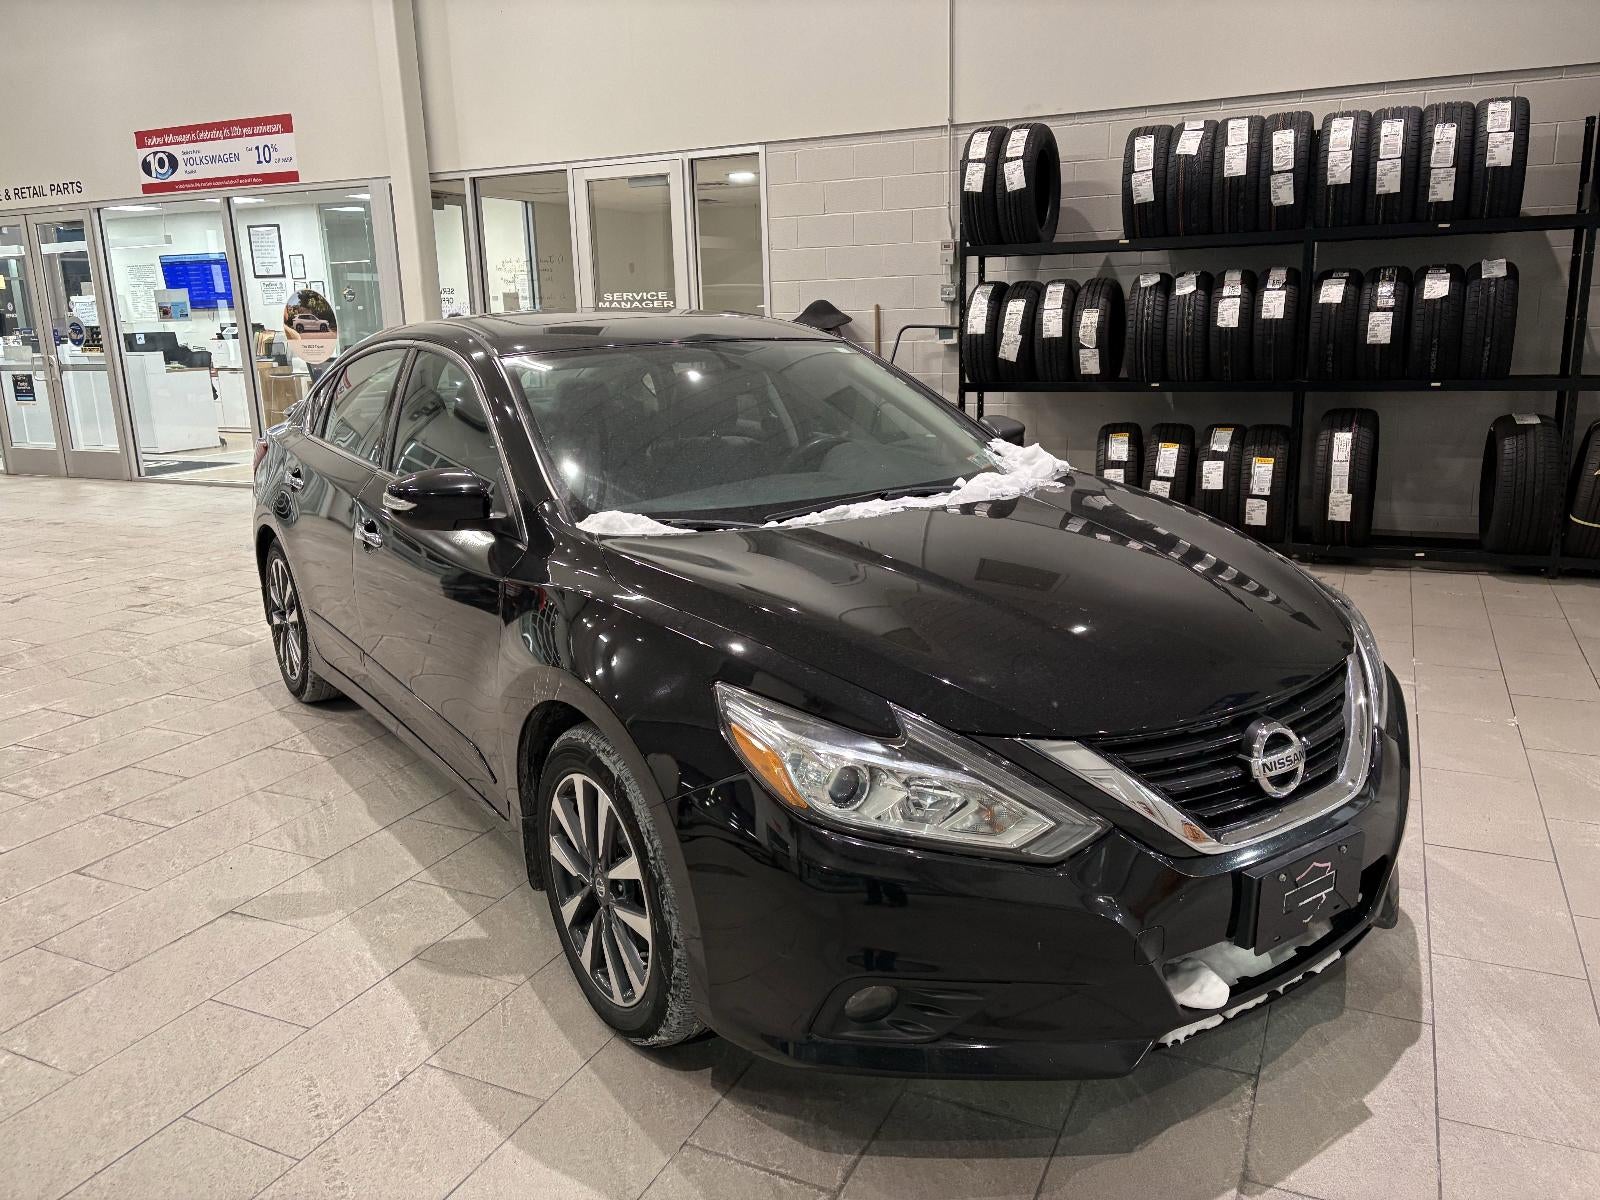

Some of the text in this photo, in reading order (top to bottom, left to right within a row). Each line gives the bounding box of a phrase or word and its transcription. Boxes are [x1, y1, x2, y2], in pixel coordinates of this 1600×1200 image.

[196, 128, 223, 140] Celebrating
[242, 126, 253, 138] year
[182, 152, 241, 167] VOLKSWAGEN
[4, 180, 83, 201] & RETAIL PARTS
[603, 291, 668, 301] SERVICE
[598, 300, 675, 309] MANAGER
[1261, 750, 1305, 774] NISSAN
